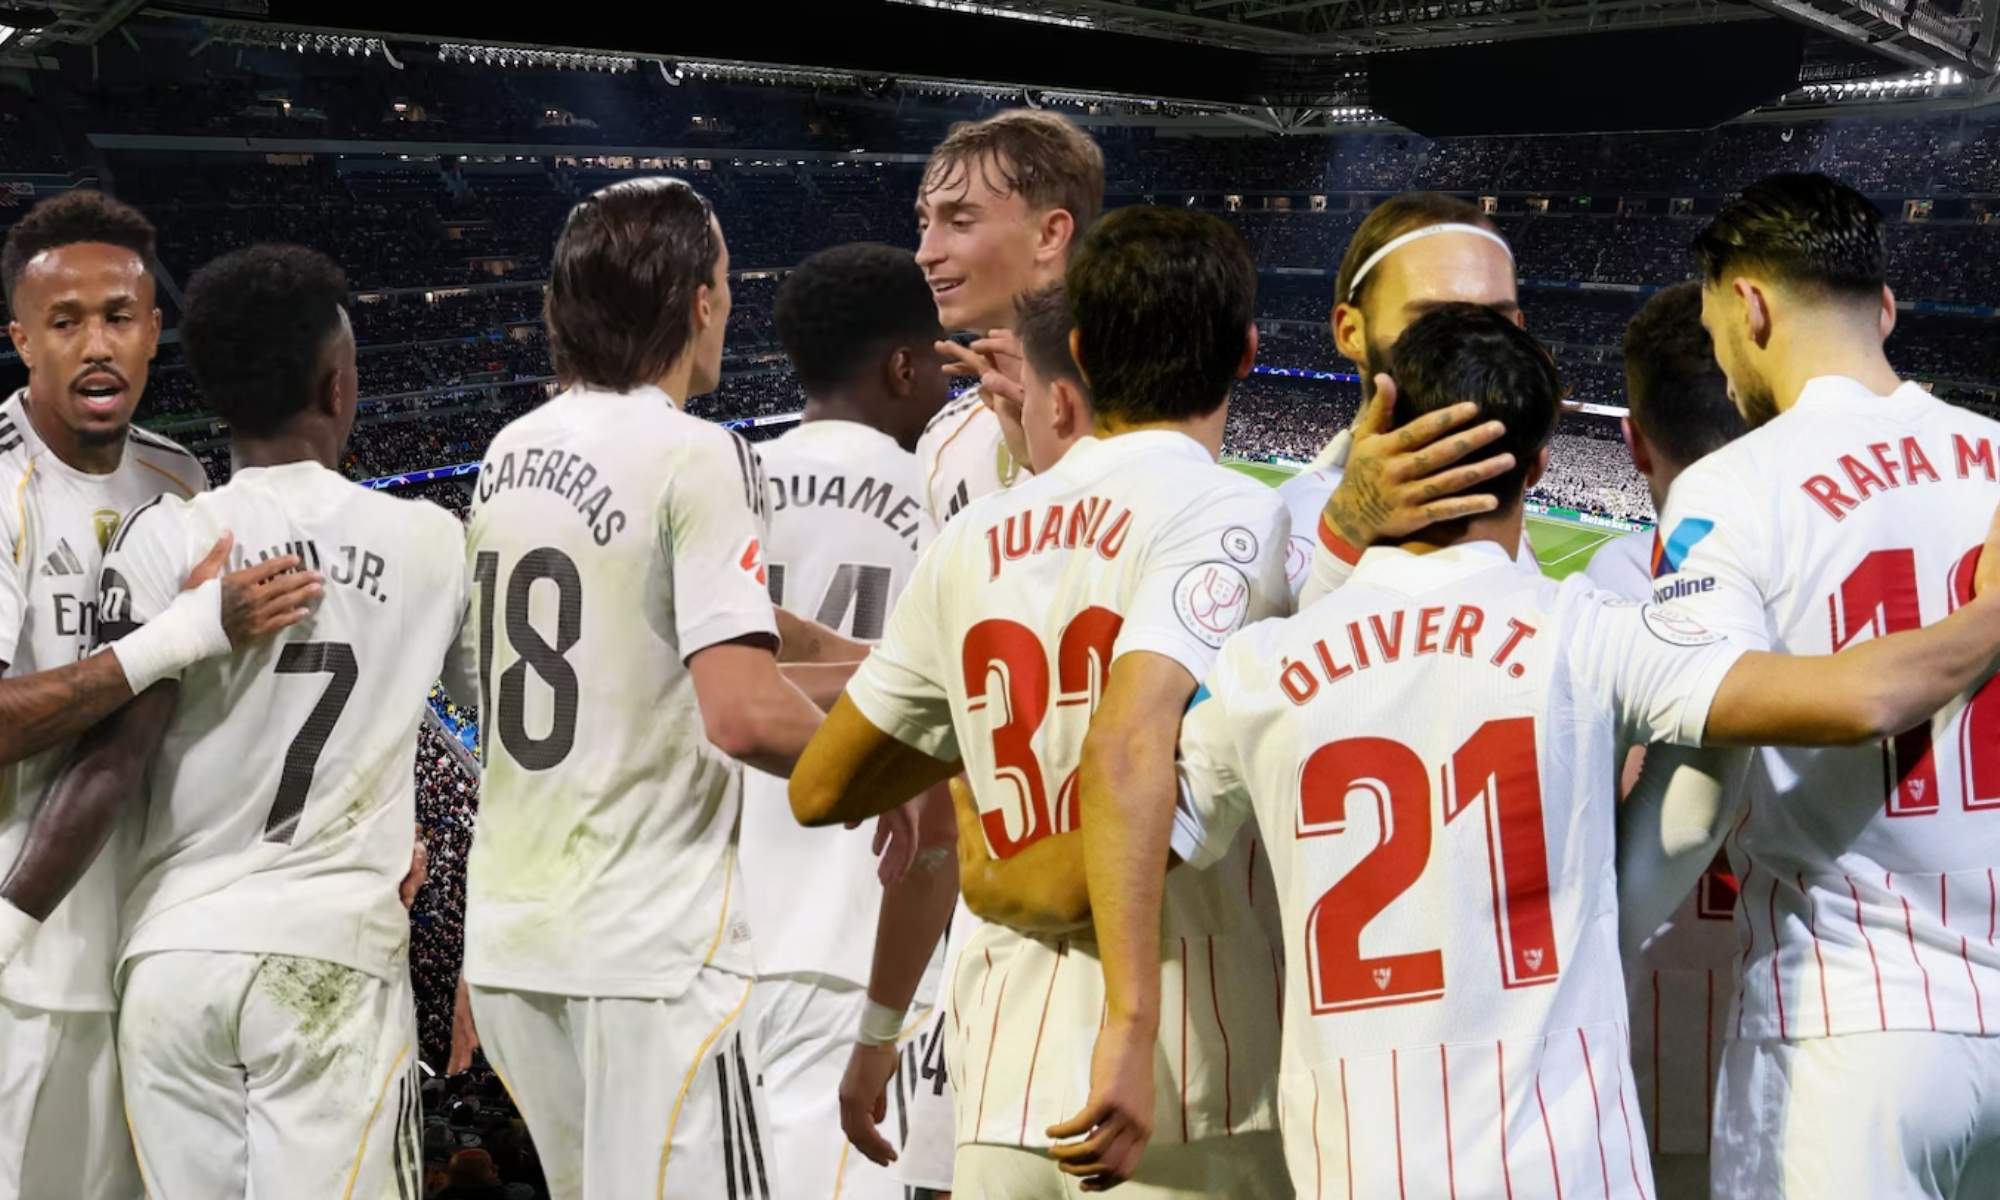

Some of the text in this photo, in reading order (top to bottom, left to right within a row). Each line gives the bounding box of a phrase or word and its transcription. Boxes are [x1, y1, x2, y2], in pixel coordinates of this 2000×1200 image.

[480, 448, 627, 547] CARRERAS
[1800, 433, 2000, 523] RAFA M
[331, 545, 387, 603] JR.
[473, 546, 582, 772] 18
[1279, 604, 1485, 706] ÓLIVER
[1489, 616, 1537, 679] T.
[262, 641, 358, 846] 7
[1295, 716, 1560, 1017] 21
